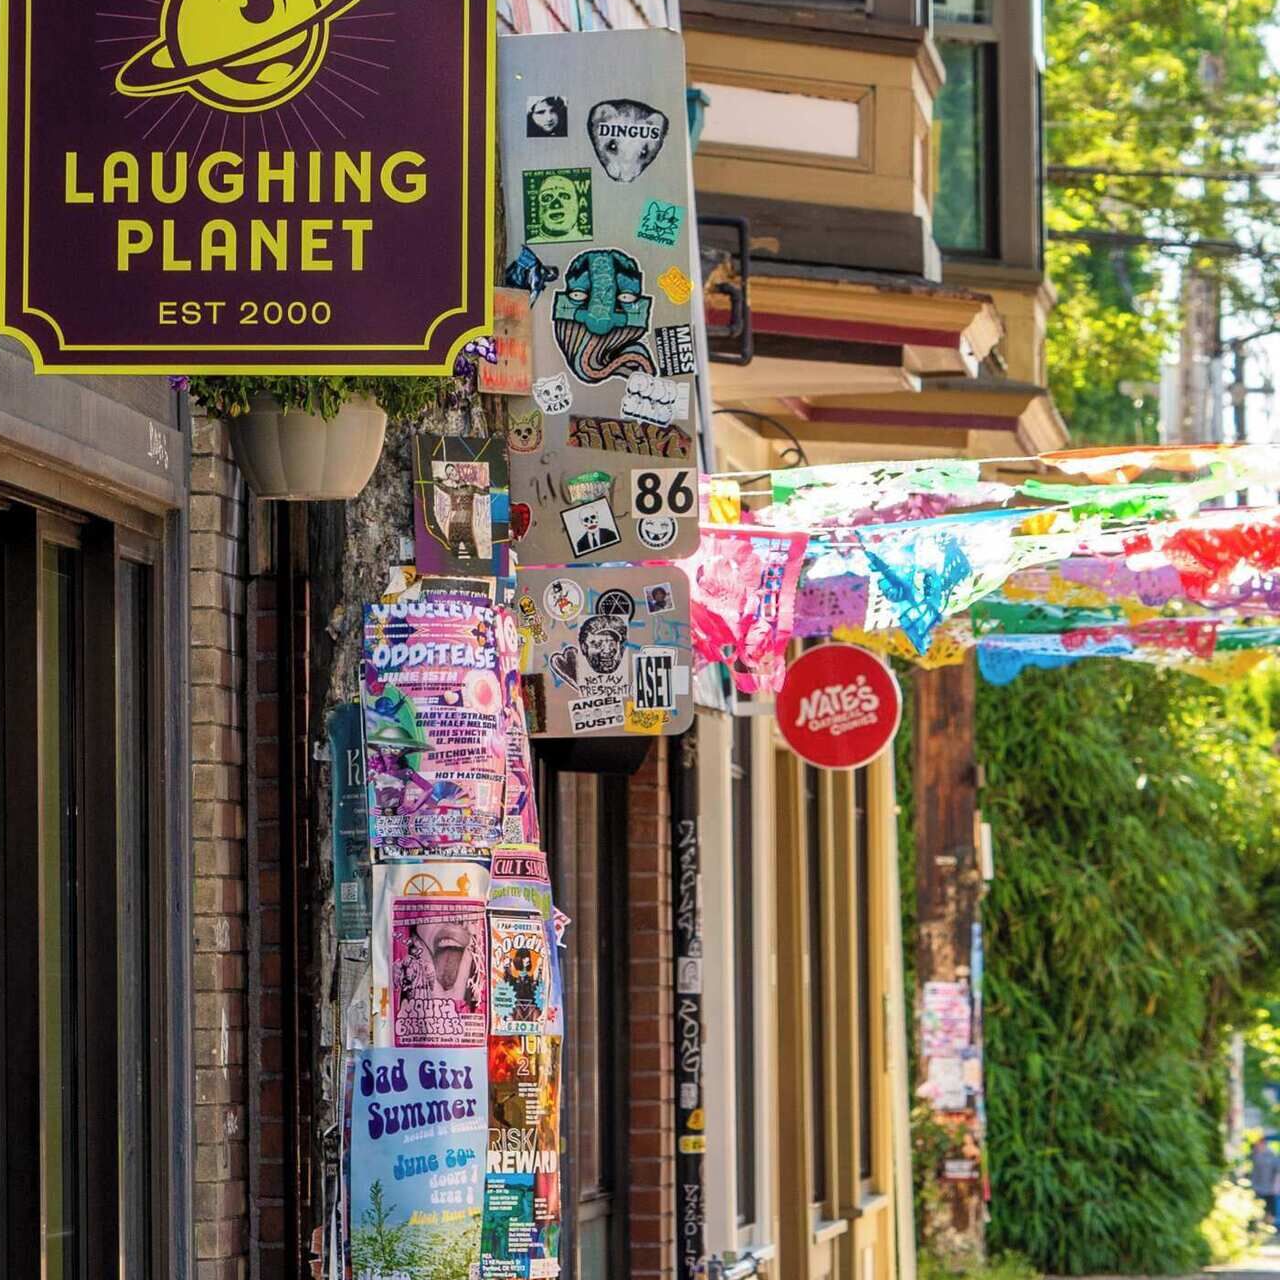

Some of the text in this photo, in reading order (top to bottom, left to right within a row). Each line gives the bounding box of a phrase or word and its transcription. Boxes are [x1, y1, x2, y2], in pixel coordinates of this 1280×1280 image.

[599, 124, 660, 139] DINGUS
[65, 152, 428, 204] LAUGHING
[116, 219, 373, 272] PLANET
[159, 301, 331, 325] EST 2000
[676, 326, 694, 374] MESS
[635, 471, 694, 515] 86
[585, 675, 623, 687] NOT MY
[636, 656, 673, 709] ASET
[572, 697, 621, 711] ANGEL
[795, 674, 880, 727] NATE'S
[575, 717, 613, 730] DUST
[495, 859, 524, 875] CULT
[396, 998, 459, 1019] MOUTH
[395, 1018, 464, 1036] BREATHER
[360, 1058, 473, 1096] Sad Girl
[368, 1098, 477, 1140] Summer
[393, 1152, 439, 1181] June
